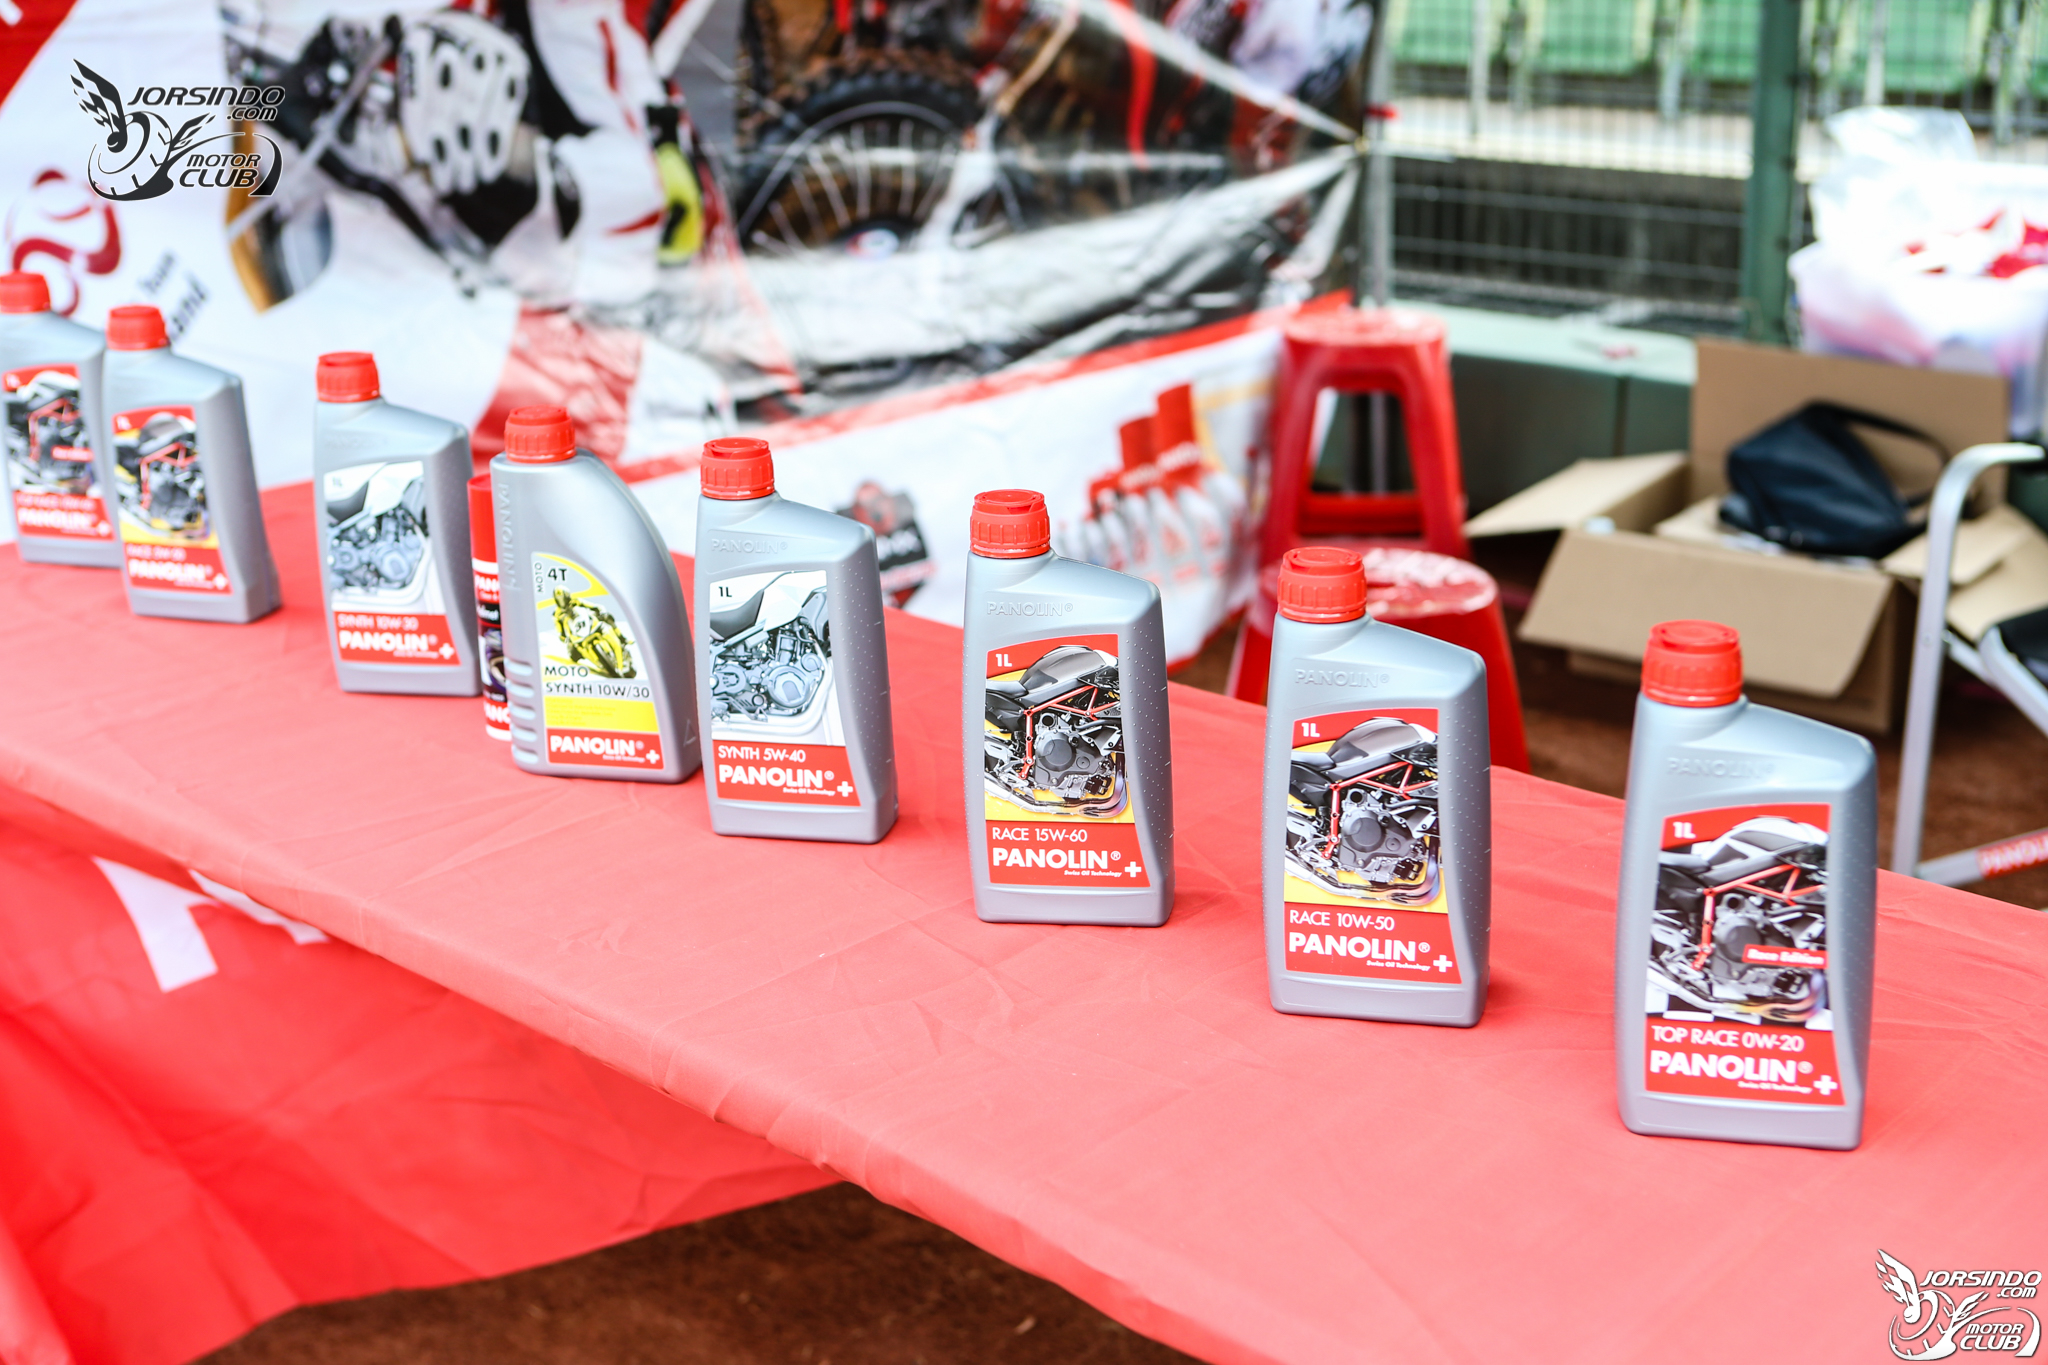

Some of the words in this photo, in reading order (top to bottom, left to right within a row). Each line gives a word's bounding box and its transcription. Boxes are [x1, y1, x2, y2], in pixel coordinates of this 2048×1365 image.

[534, 562, 544, 593] MOTO
[547, 568, 568, 582] 4T
[718, 586, 733, 598] 1L
[996, 653, 1013, 667] 1L
[544, 666, 589, 678] MOTO
[545, 682, 593, 695] SYNTH
[597, 684, 650, 699] 10W/30
[1301, 722, 1320, 738] 1L
[718, 745, 760, 760] SYNTH
[763, 747, 806, 763] 5W-40
[992, 827, 1029, 841] RACE
[1034, 828, 1088, 843] 15W-60
[1672, 821, 1697, 839] 1L
[1091, 870, 1122, 878] Technology
[1289, 909, 1331, 927] RACE
[1336, 912, 1395, 931] 10W-50
[1746, 948, 1779, 962] Race
[1780, 951, 1825, 966] Edition
[1366, 960, 1385, 968] Swiss
[1385, 961, 1395, 969] Oil
[1396, 962, 1431, 972] Technology
[1651, 1025, 1688, 1044] TOP
[1691, 1028, 1740, 1048] RACE
[1741, 1031, 1805, 1053] 0W-20
